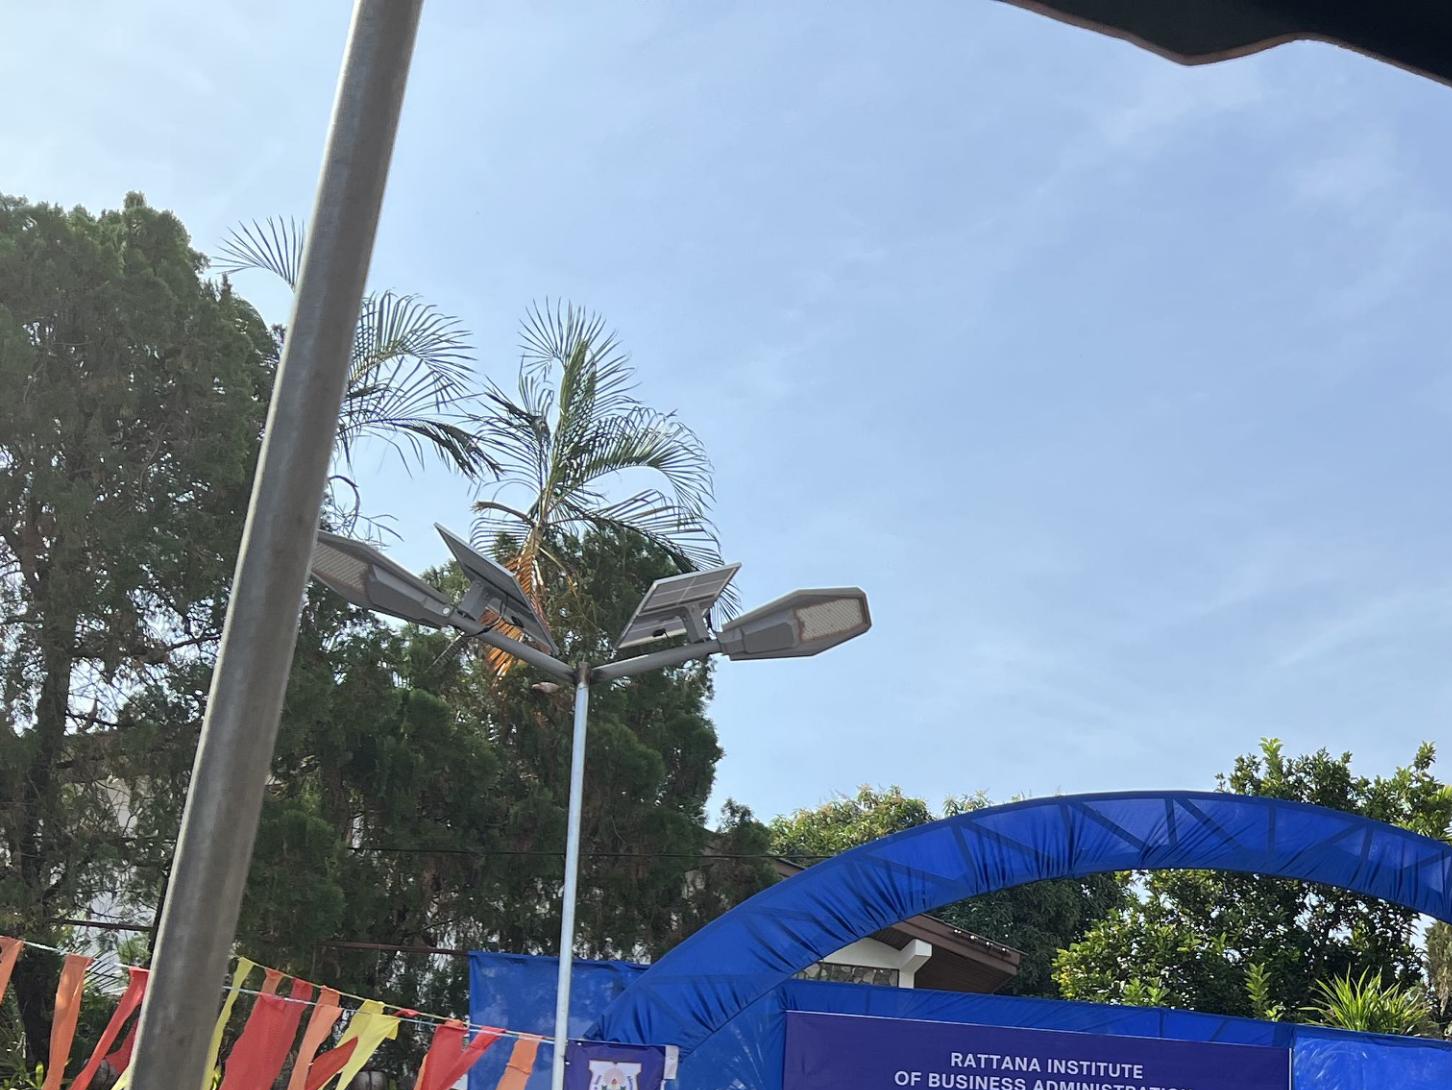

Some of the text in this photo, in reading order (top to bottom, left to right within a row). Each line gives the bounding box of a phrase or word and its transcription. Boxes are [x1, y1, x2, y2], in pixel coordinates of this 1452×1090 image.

[950, 1052, 1144, 1080] RATTANA INSTITUTE
[894, 1070, 922, 1087] OF
